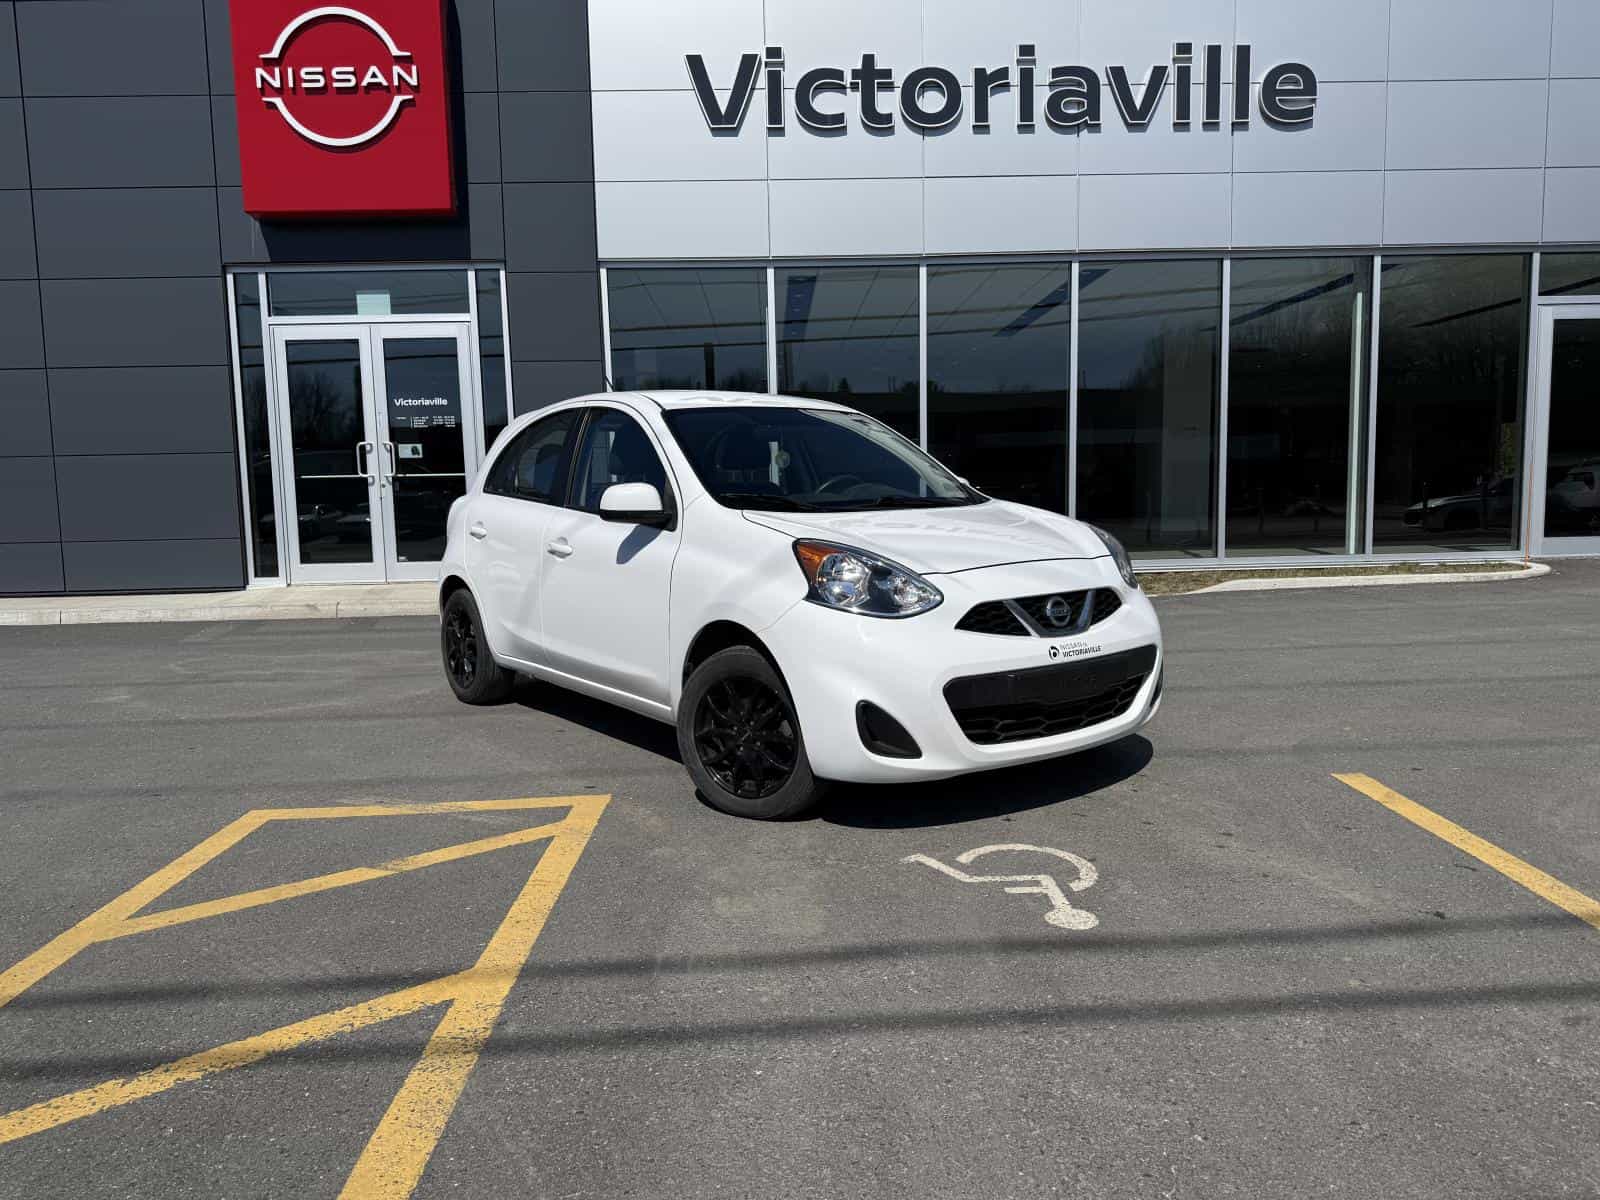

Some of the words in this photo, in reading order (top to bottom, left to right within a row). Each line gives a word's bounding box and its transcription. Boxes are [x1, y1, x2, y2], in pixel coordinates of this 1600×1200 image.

[255, 65, 418, 88] NISSAN
[685, 43, 1318, 133] Victoriaville
[394, 397, 448, 406] Victoriaville
